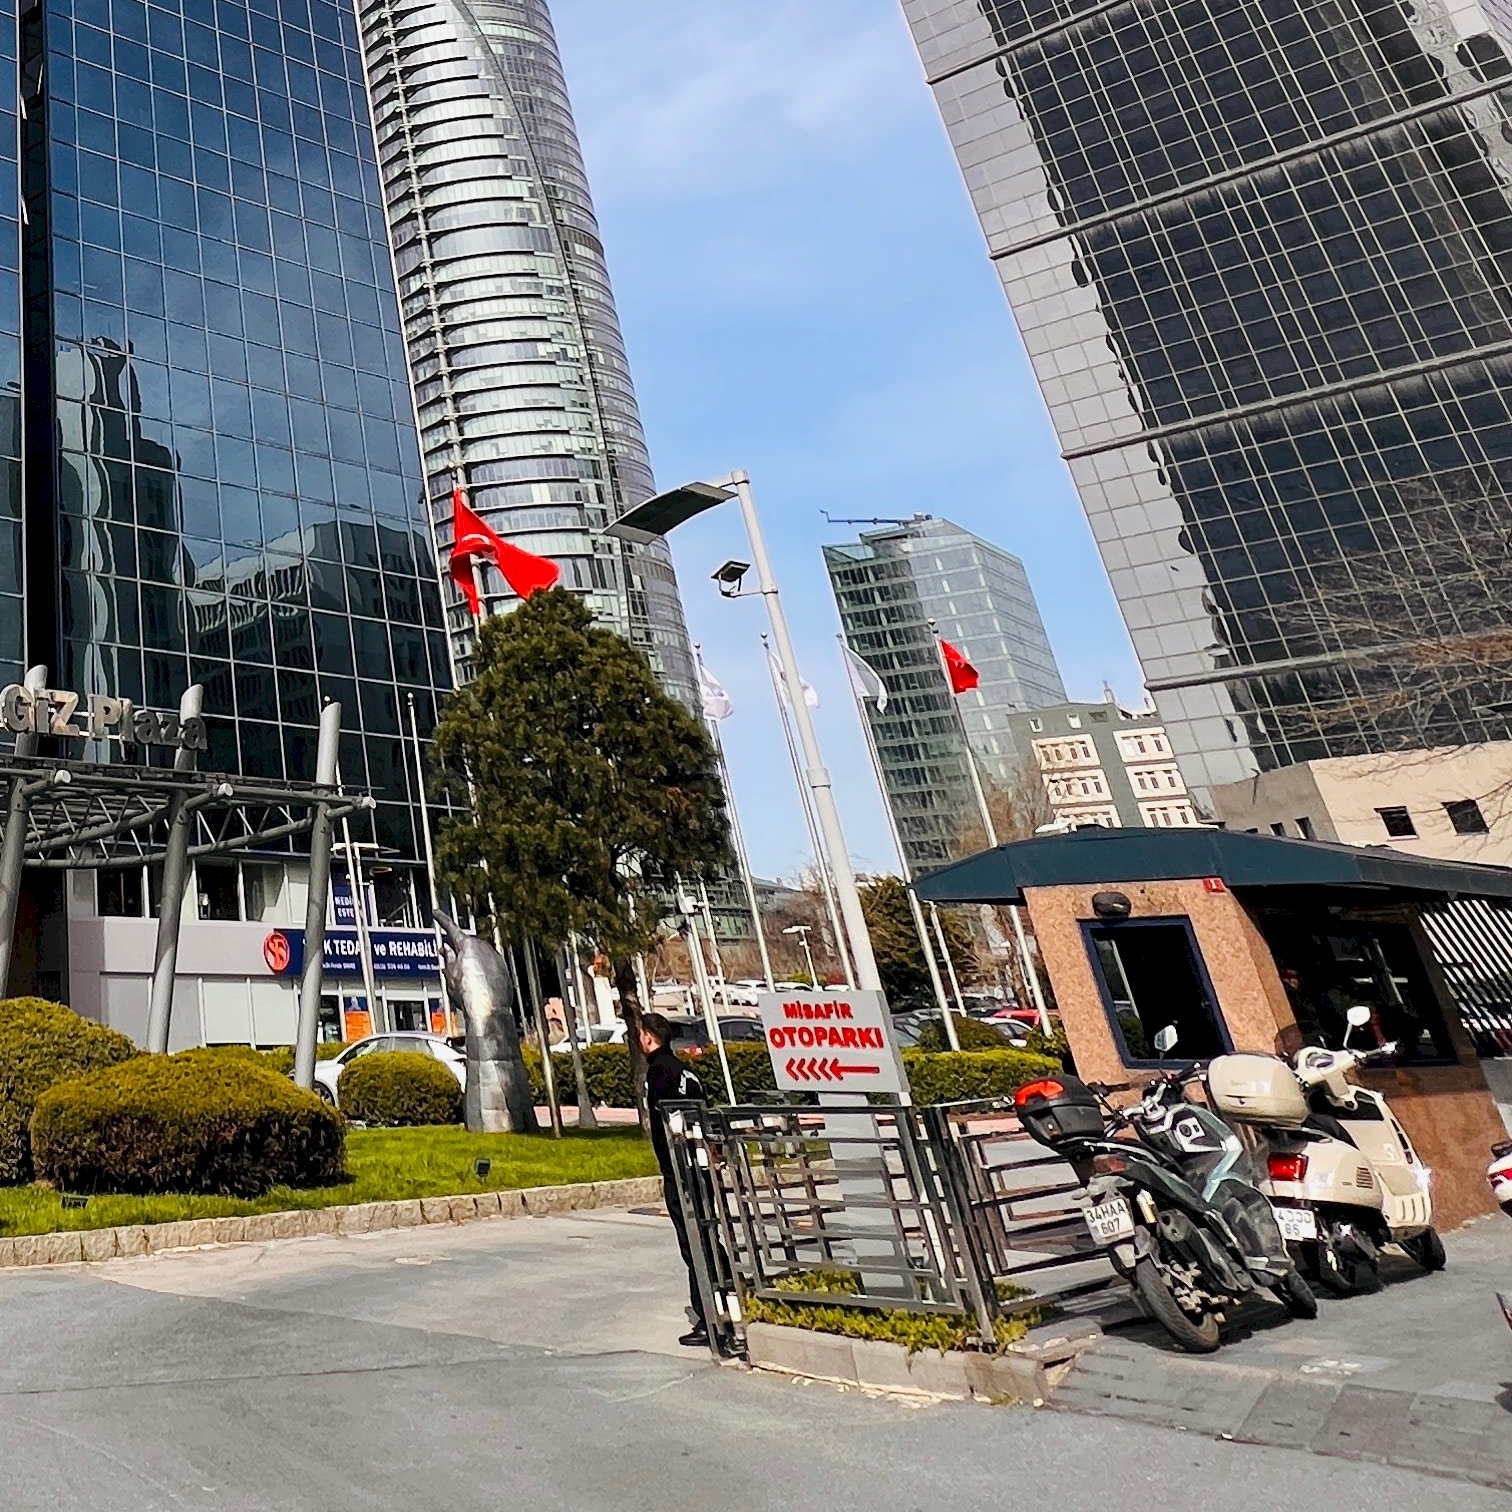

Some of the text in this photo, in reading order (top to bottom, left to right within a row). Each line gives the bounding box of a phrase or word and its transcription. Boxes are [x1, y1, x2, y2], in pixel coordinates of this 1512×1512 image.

[88, 693, 208, 751] Plaza
[374, 944, 387, 956] ve
[783, 1000, 854, 1020] MİSAFİR
[769, 1026, 885, 1049] OTOPARKI
[1100, 1217, 1120, 1235] 607
